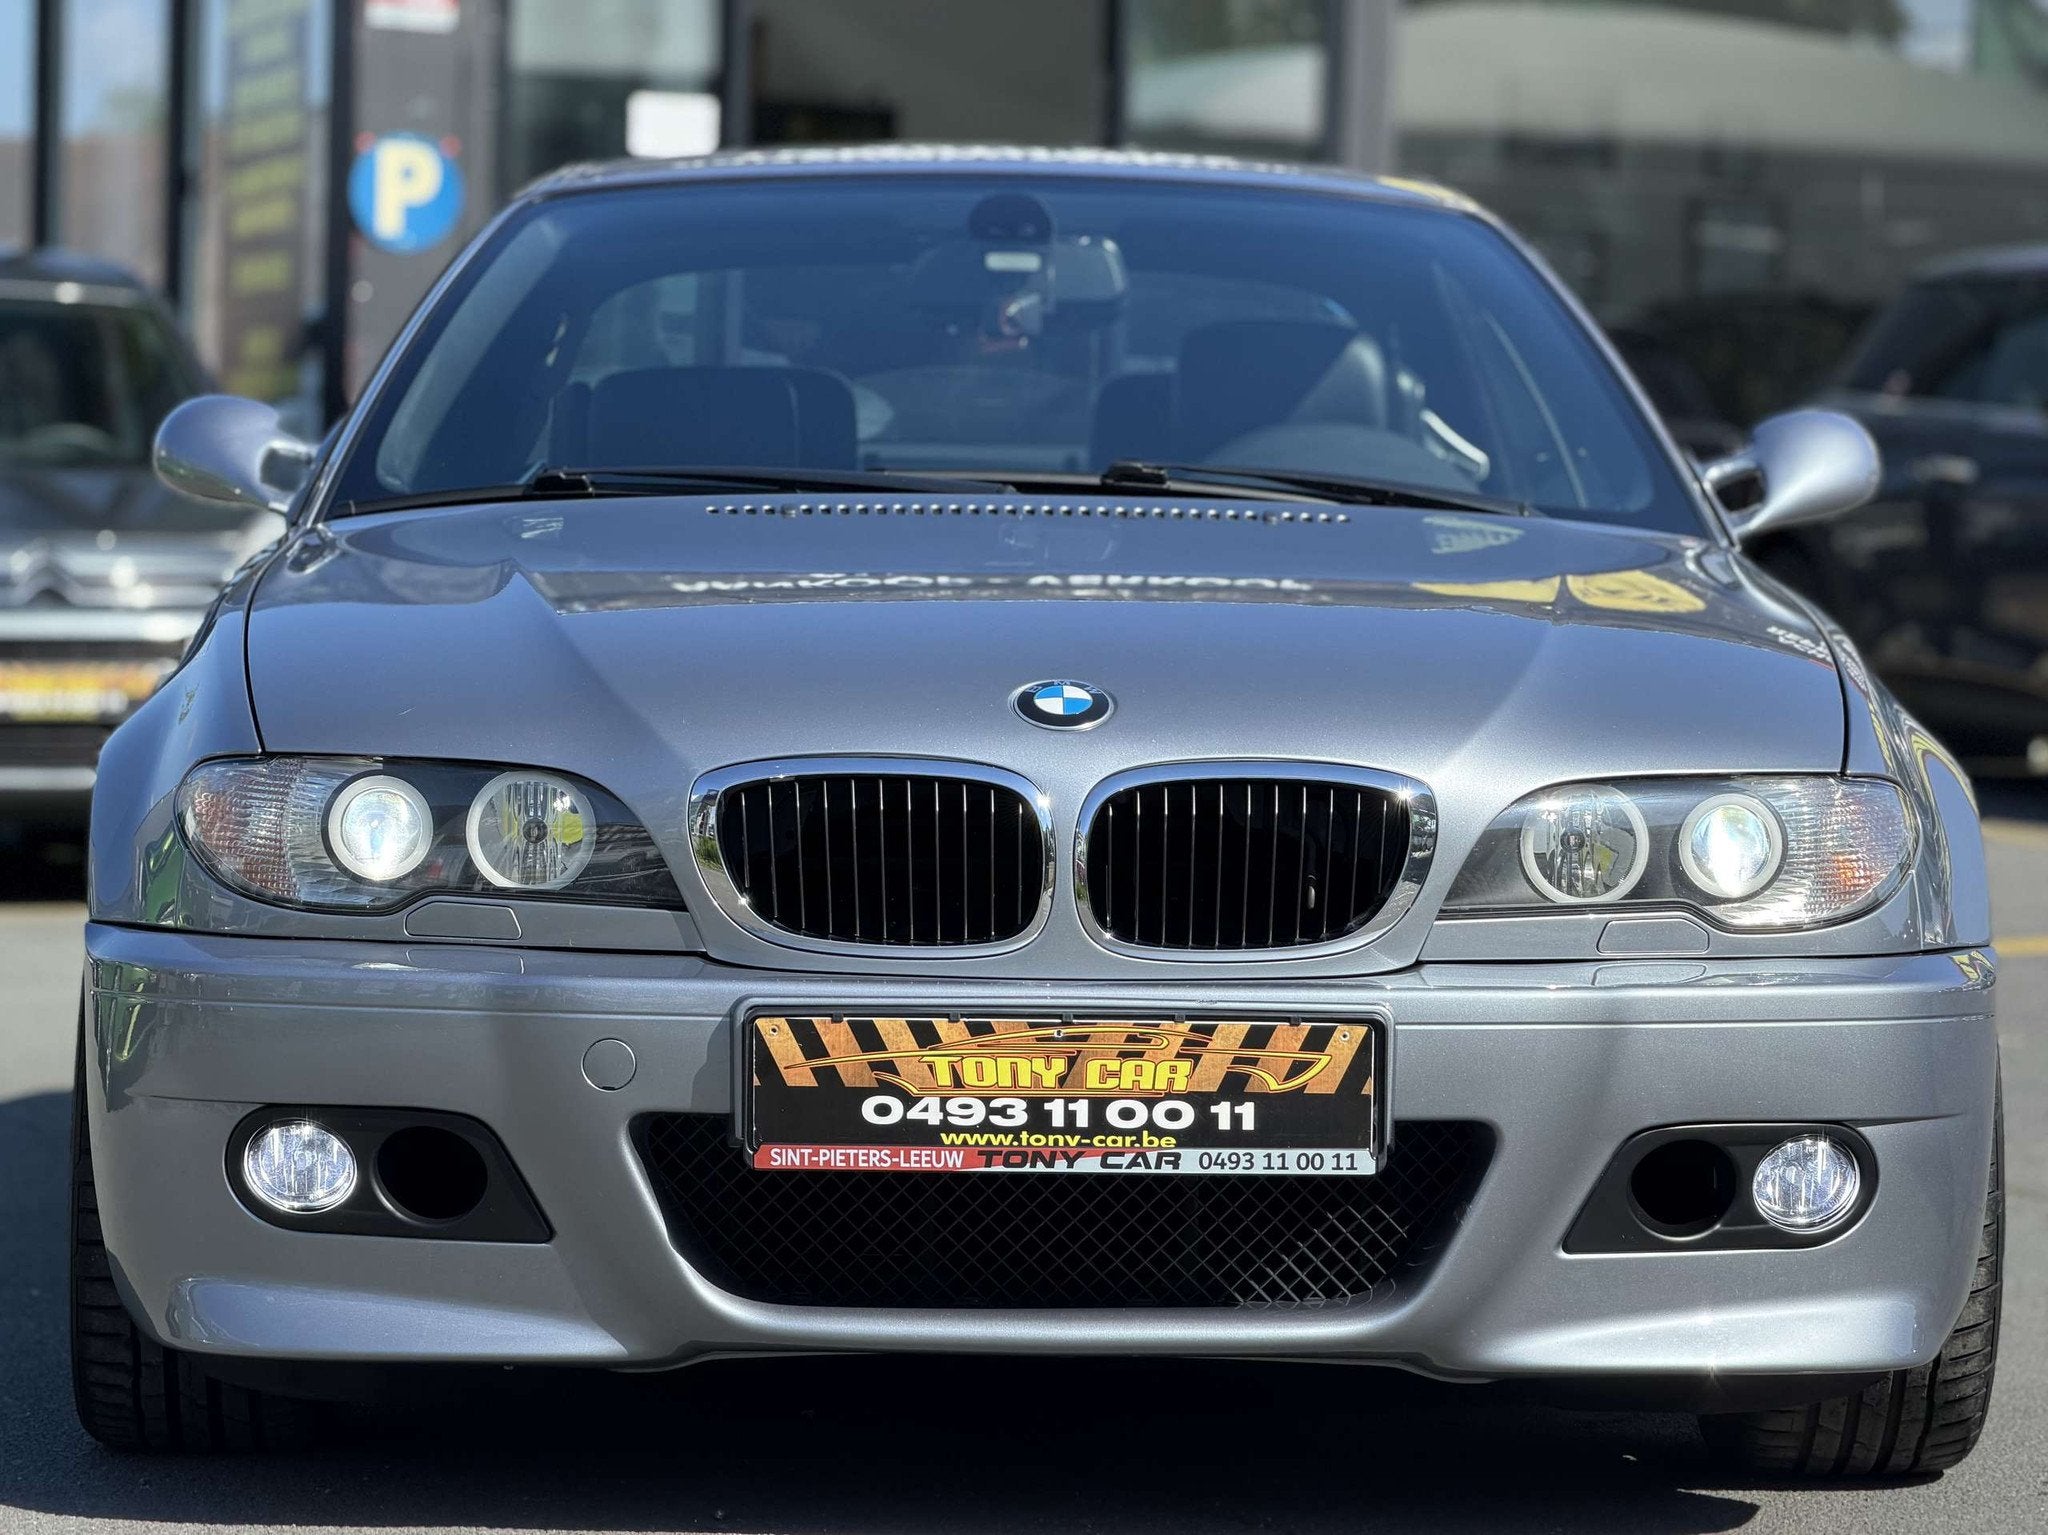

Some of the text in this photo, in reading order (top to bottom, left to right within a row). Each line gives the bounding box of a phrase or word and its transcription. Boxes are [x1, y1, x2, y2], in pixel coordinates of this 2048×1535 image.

[373, 138, 444, 240] P
[919, 1055, 1193, 1092] TONY CAR
[861, 1095, 1255, 1131] 0493 11 00 11
[769, 1147, 964, 1169] SINT-PIETERS-LEEUW
[977, 1150, 1182, 1170] TONY CAR
[1198, 1152, 1358, 1171] 0493 11 00 11
